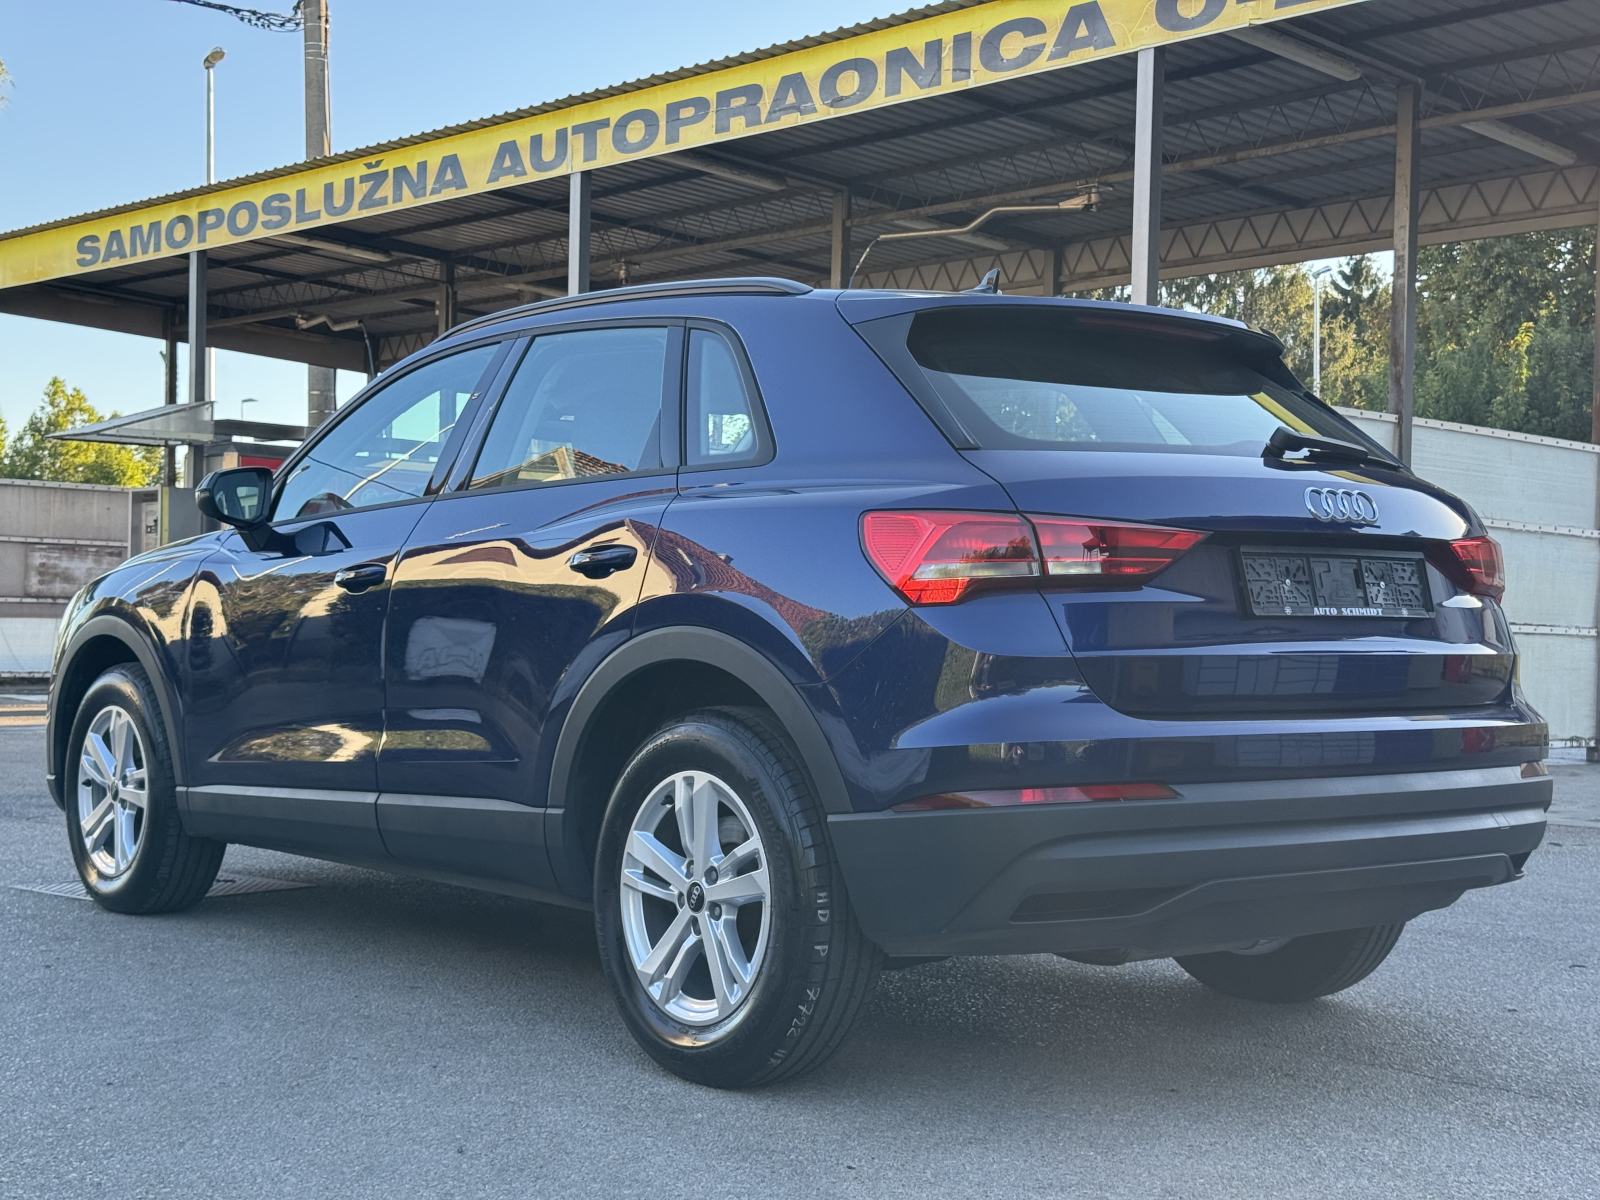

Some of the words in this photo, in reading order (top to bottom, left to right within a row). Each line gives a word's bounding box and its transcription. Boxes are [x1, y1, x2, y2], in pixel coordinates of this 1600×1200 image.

[76, 159, 468, 268] SAMOPOSLUŽNA
[486, 0, 1116, 183] AUTOPRAONICA
[1313, 607, 1337, 616] AUTO
[1341, 607, 1384, 616] SCHMIDT
